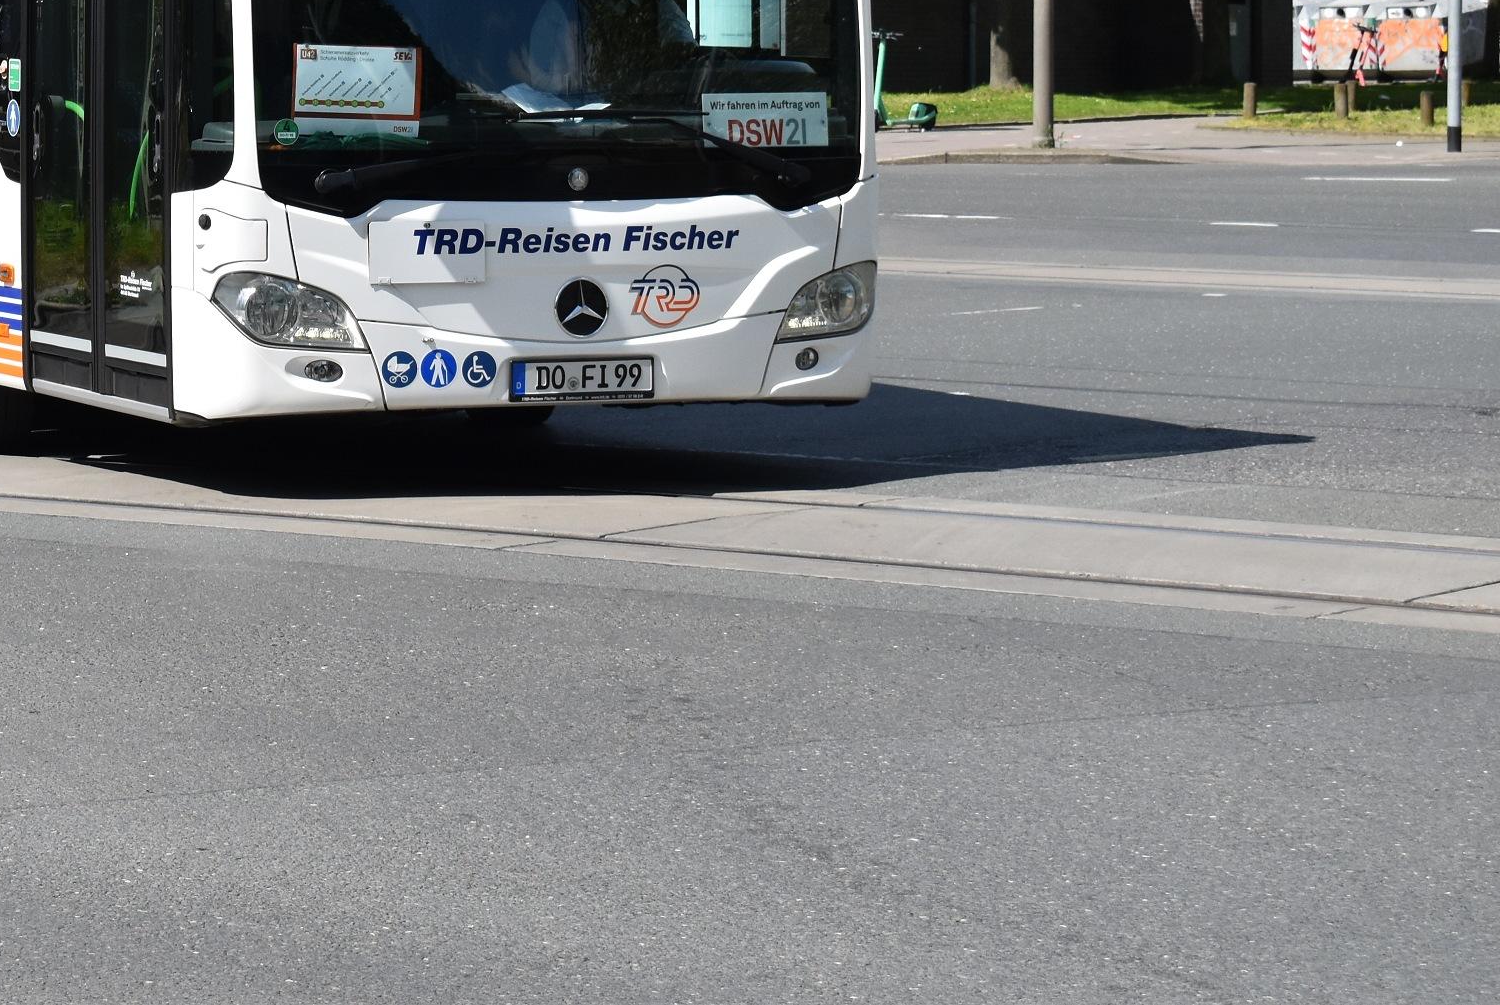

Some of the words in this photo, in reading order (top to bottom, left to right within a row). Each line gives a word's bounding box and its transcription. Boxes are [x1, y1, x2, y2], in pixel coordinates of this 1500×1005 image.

[301, 48, 316, 59] U42
[710, 101, 725, 110] Wir
[727, 101, 756, 110] fahren
[758, 100, 768, 109] im
[771, 100, 802, 111] Auftrag
[805, 101, 820, 109] von
[728, 118, 807, 146] DSW21
[413, 227, 611, 255] TRD-Reisen
[622, 225, 740, 251] Fischer
[536, 365, 565, 390] DO
[582, 364, 609, 388] FI
[614, 363, 642, 387] 99
